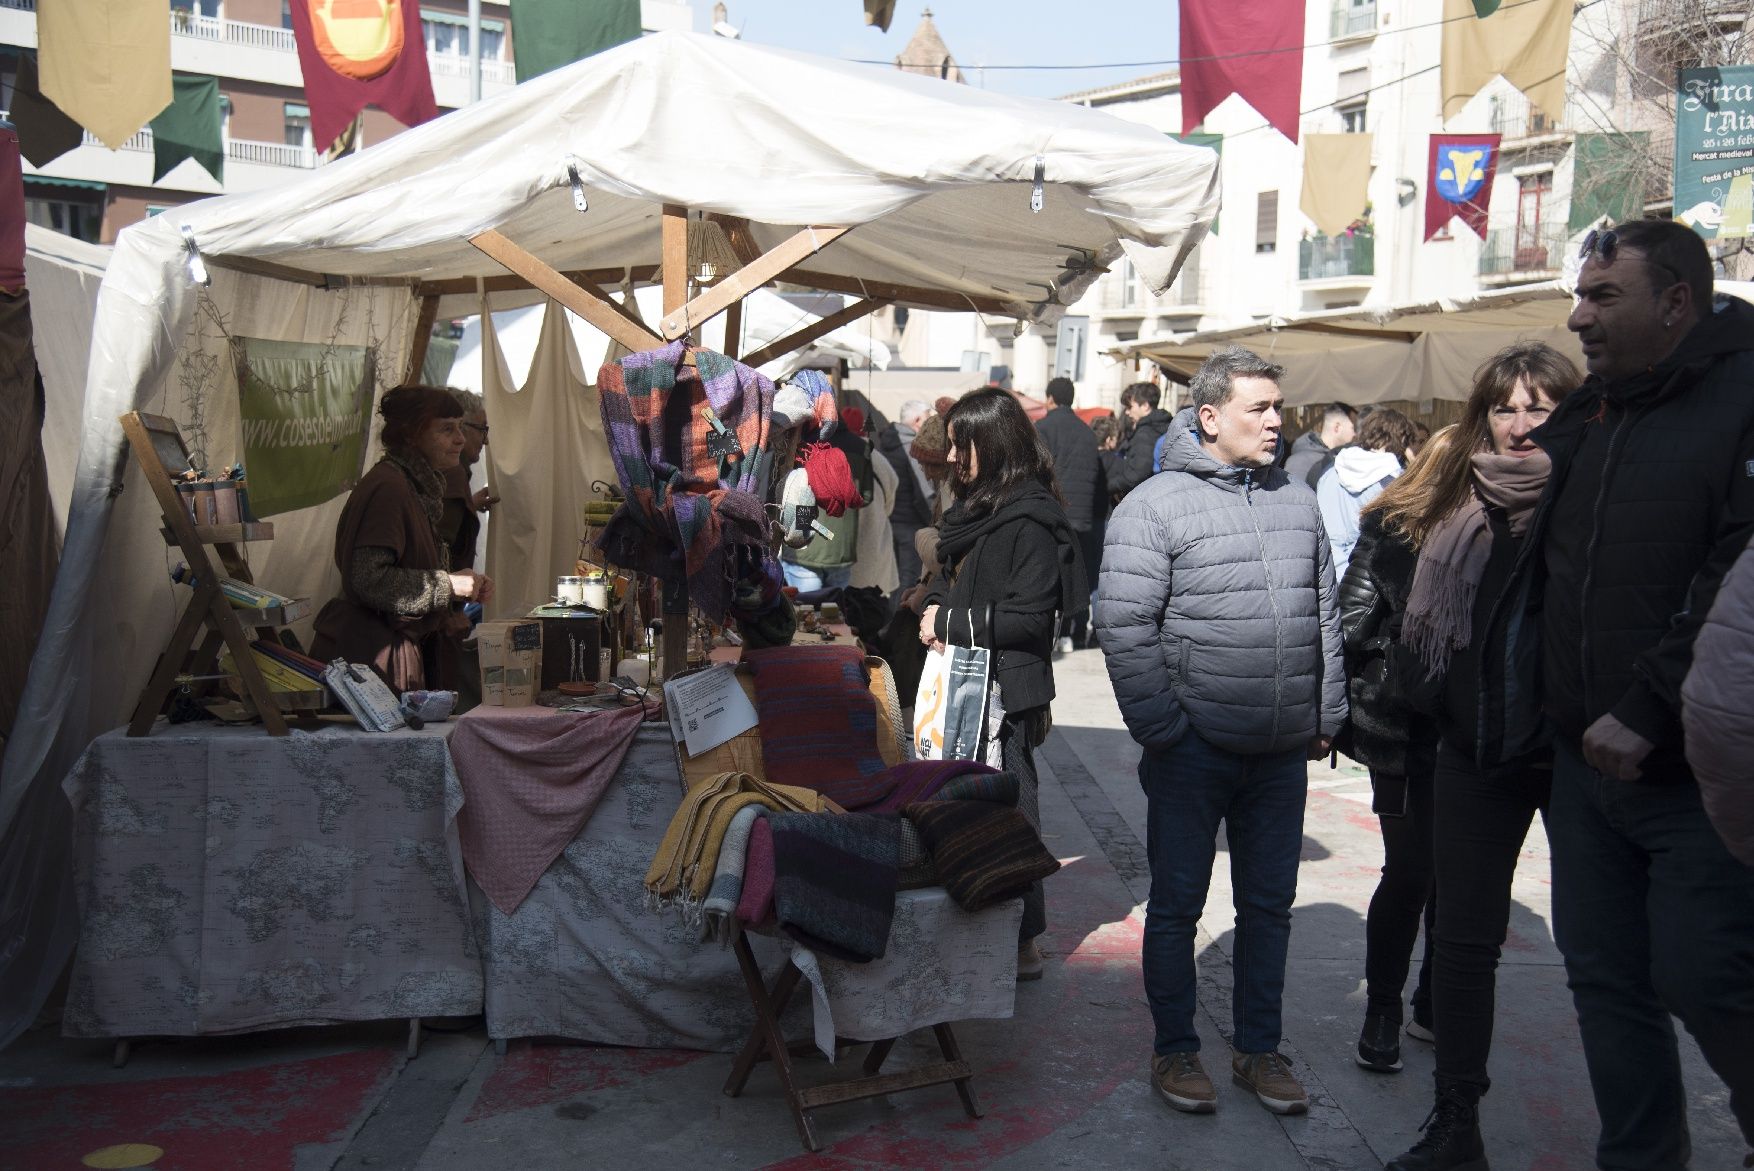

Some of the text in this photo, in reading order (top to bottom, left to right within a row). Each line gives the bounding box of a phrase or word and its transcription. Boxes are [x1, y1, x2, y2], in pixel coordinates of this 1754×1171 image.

[1683, 79, 1753, 111] Fira
[1702, 138, 1716, 148] 25
[1692, 149, 1753, 161] Mercat medieval
[1702, 173, 1721, 184] Festa
[1722, 171, 1732, 180] de
[1733, 169, 1741, 177] la
